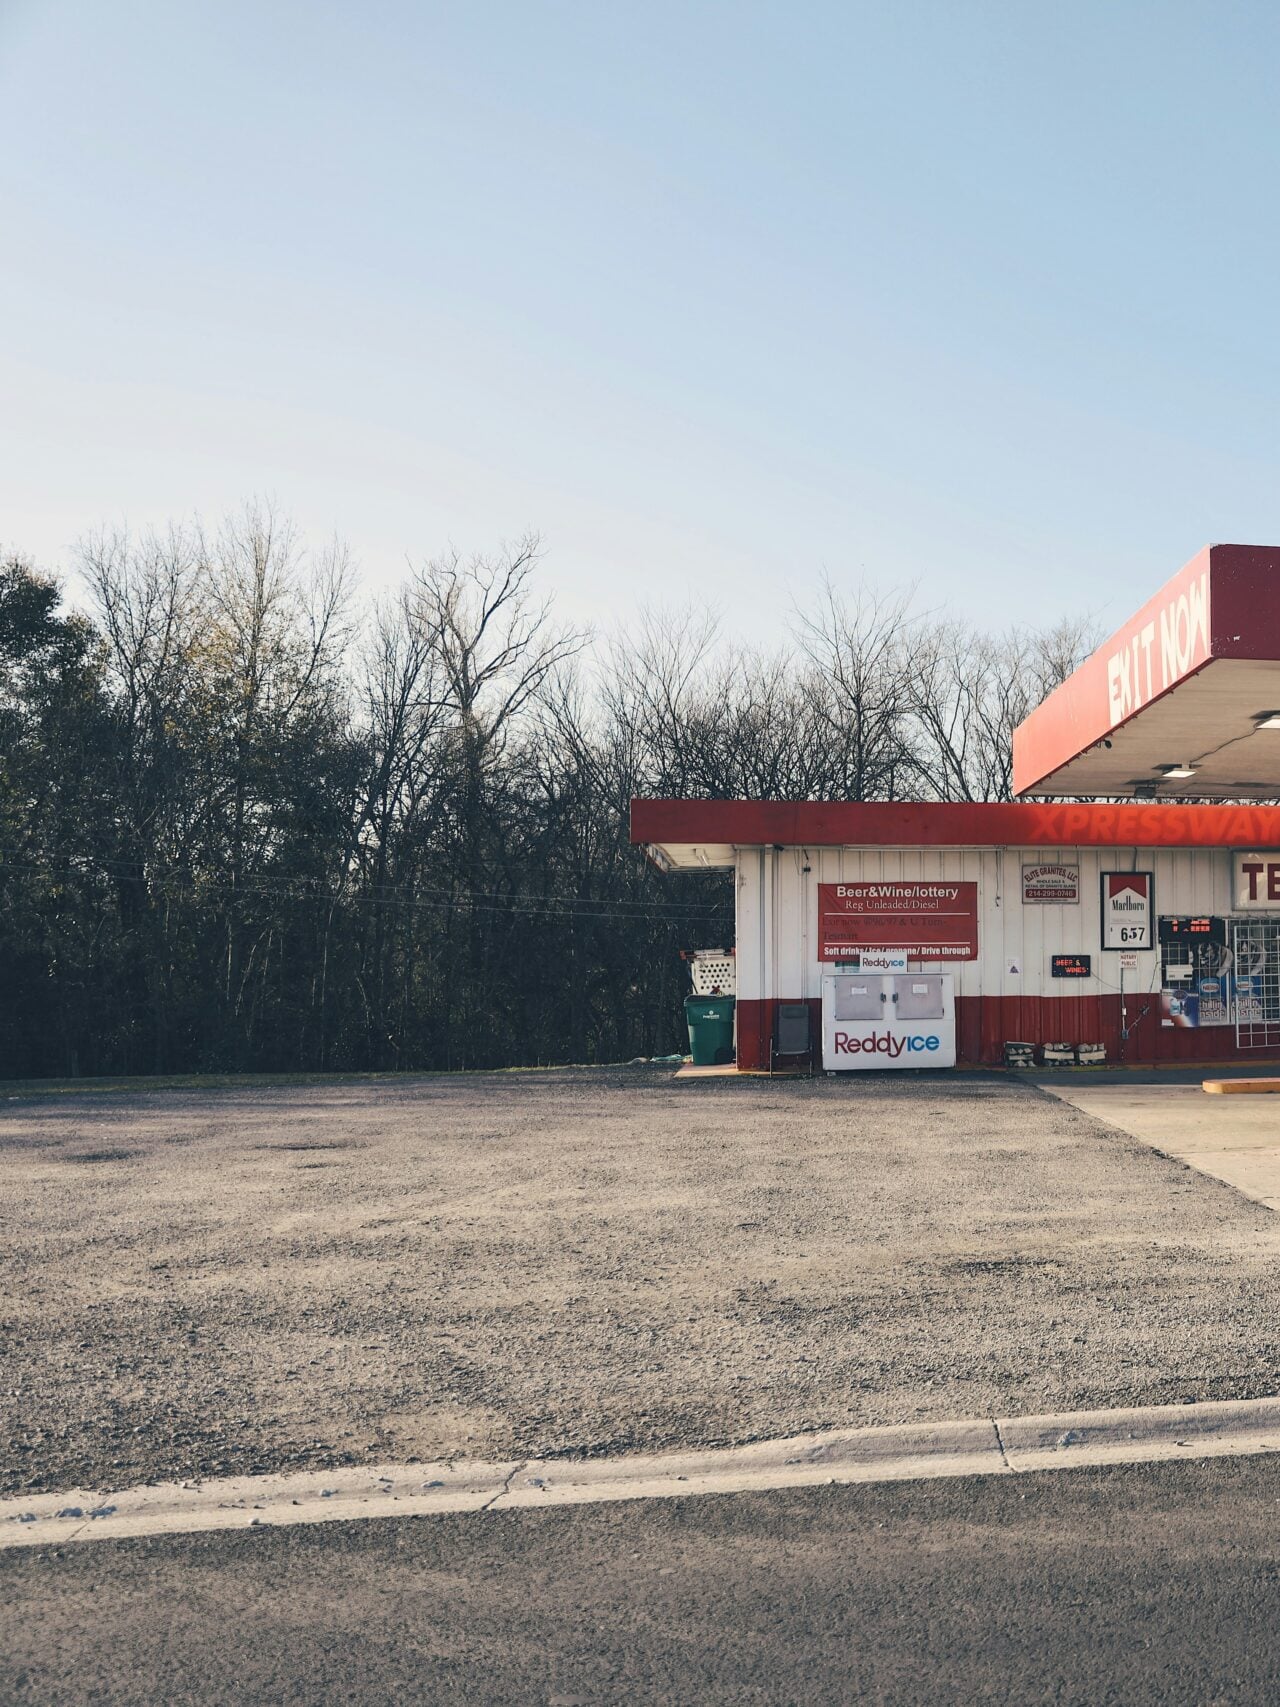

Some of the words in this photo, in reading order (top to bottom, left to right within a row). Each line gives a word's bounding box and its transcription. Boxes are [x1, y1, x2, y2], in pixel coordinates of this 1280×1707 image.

[1107, 620, 1155, 728] EXIT
[1024, 869, 1040, 882] ELITE
[836, 886, 959, 900] Beer&Wine/lottery
[845, 900, 863, 911] Reg
[866, 900, 939, 910] Unleaded/Diesel
[1111, 895, 1145, 911] Marlboro
[824, 946, 839, 956] Soft
[921, 946, 941, 955] Drive
[941, 946, 971, 956] through
